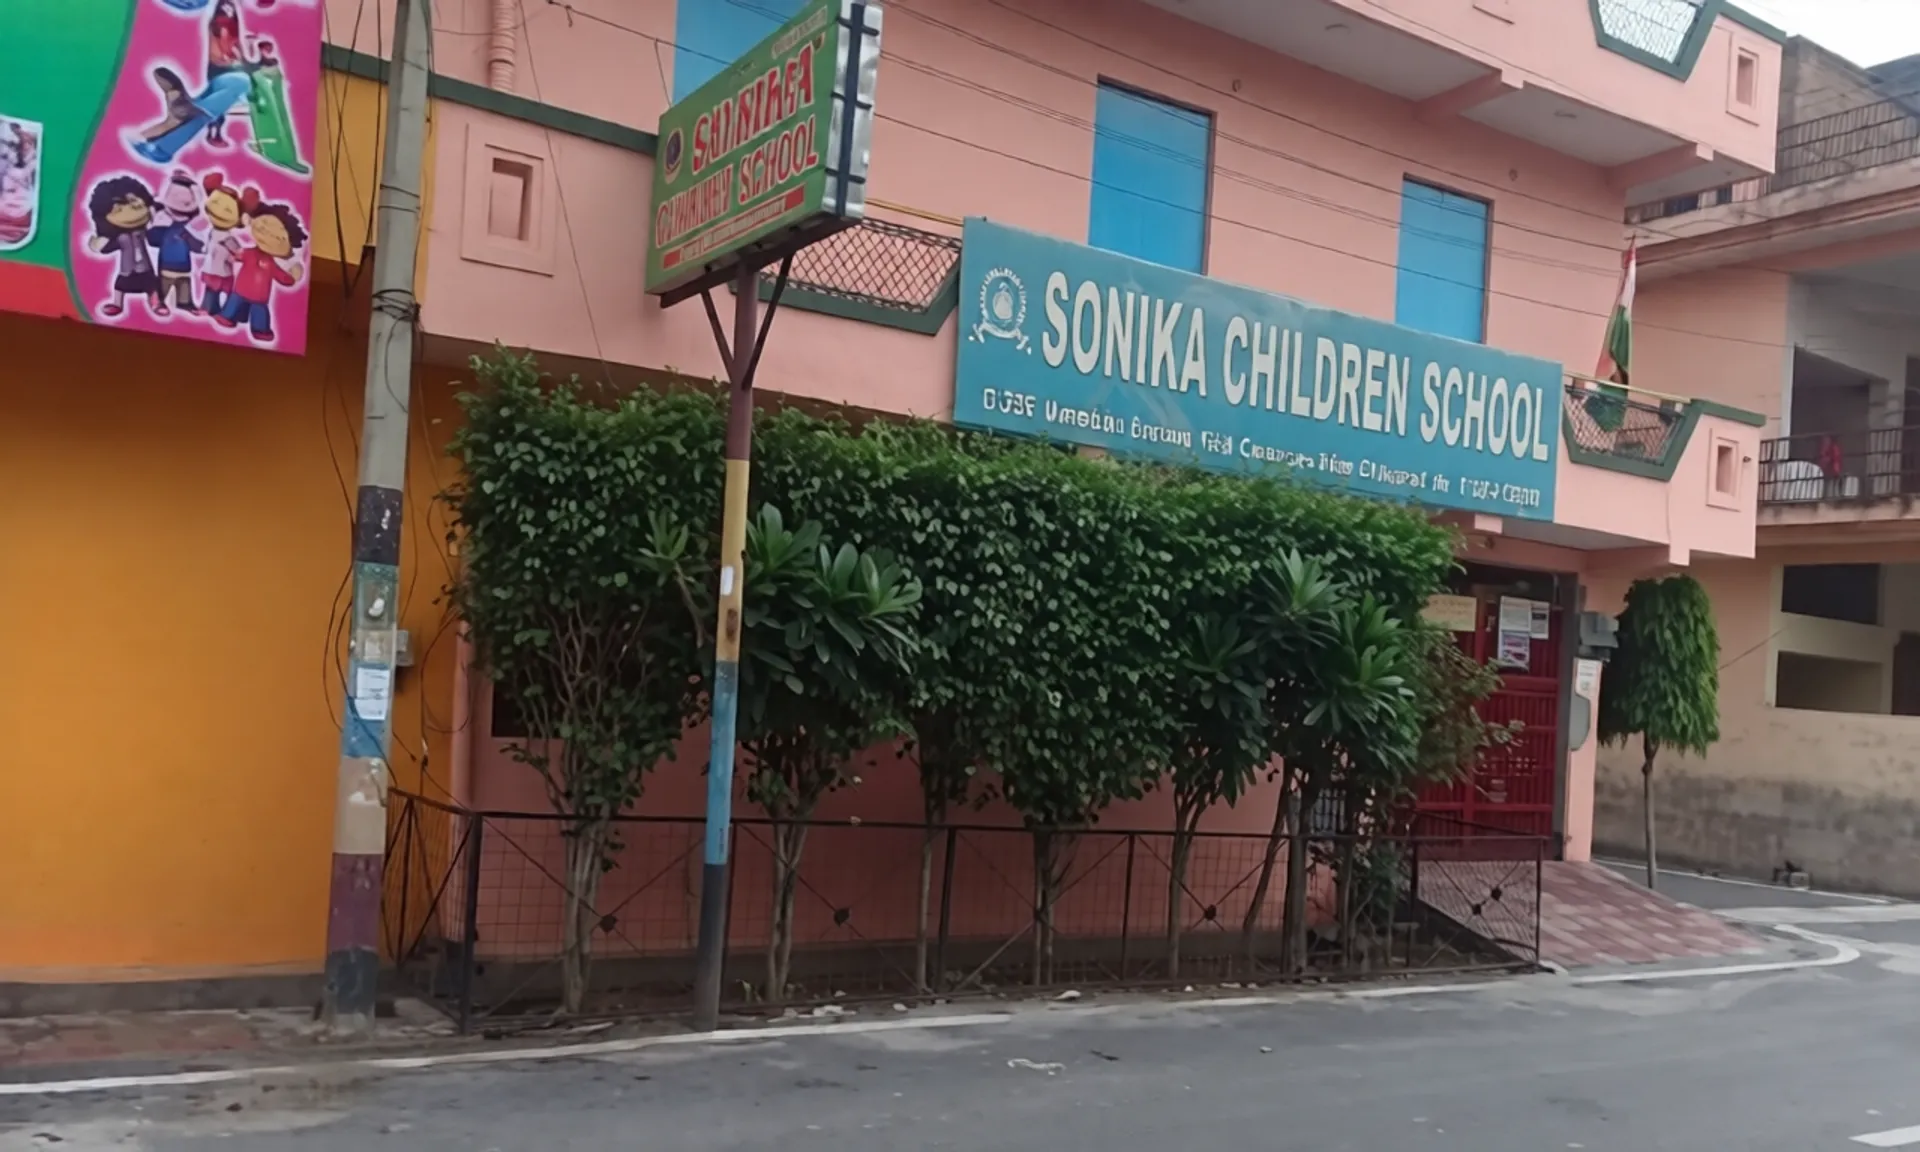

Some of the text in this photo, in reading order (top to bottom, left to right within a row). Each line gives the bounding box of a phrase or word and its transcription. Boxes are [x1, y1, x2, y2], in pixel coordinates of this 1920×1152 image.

[739, 114, 818, 204] SCHOOL
[1042, 271, 1207, 397] SONIKA
[1223, 315, 1410, 436] CHILDREN
[1420, 361, 1550, 461] SCHOOL
